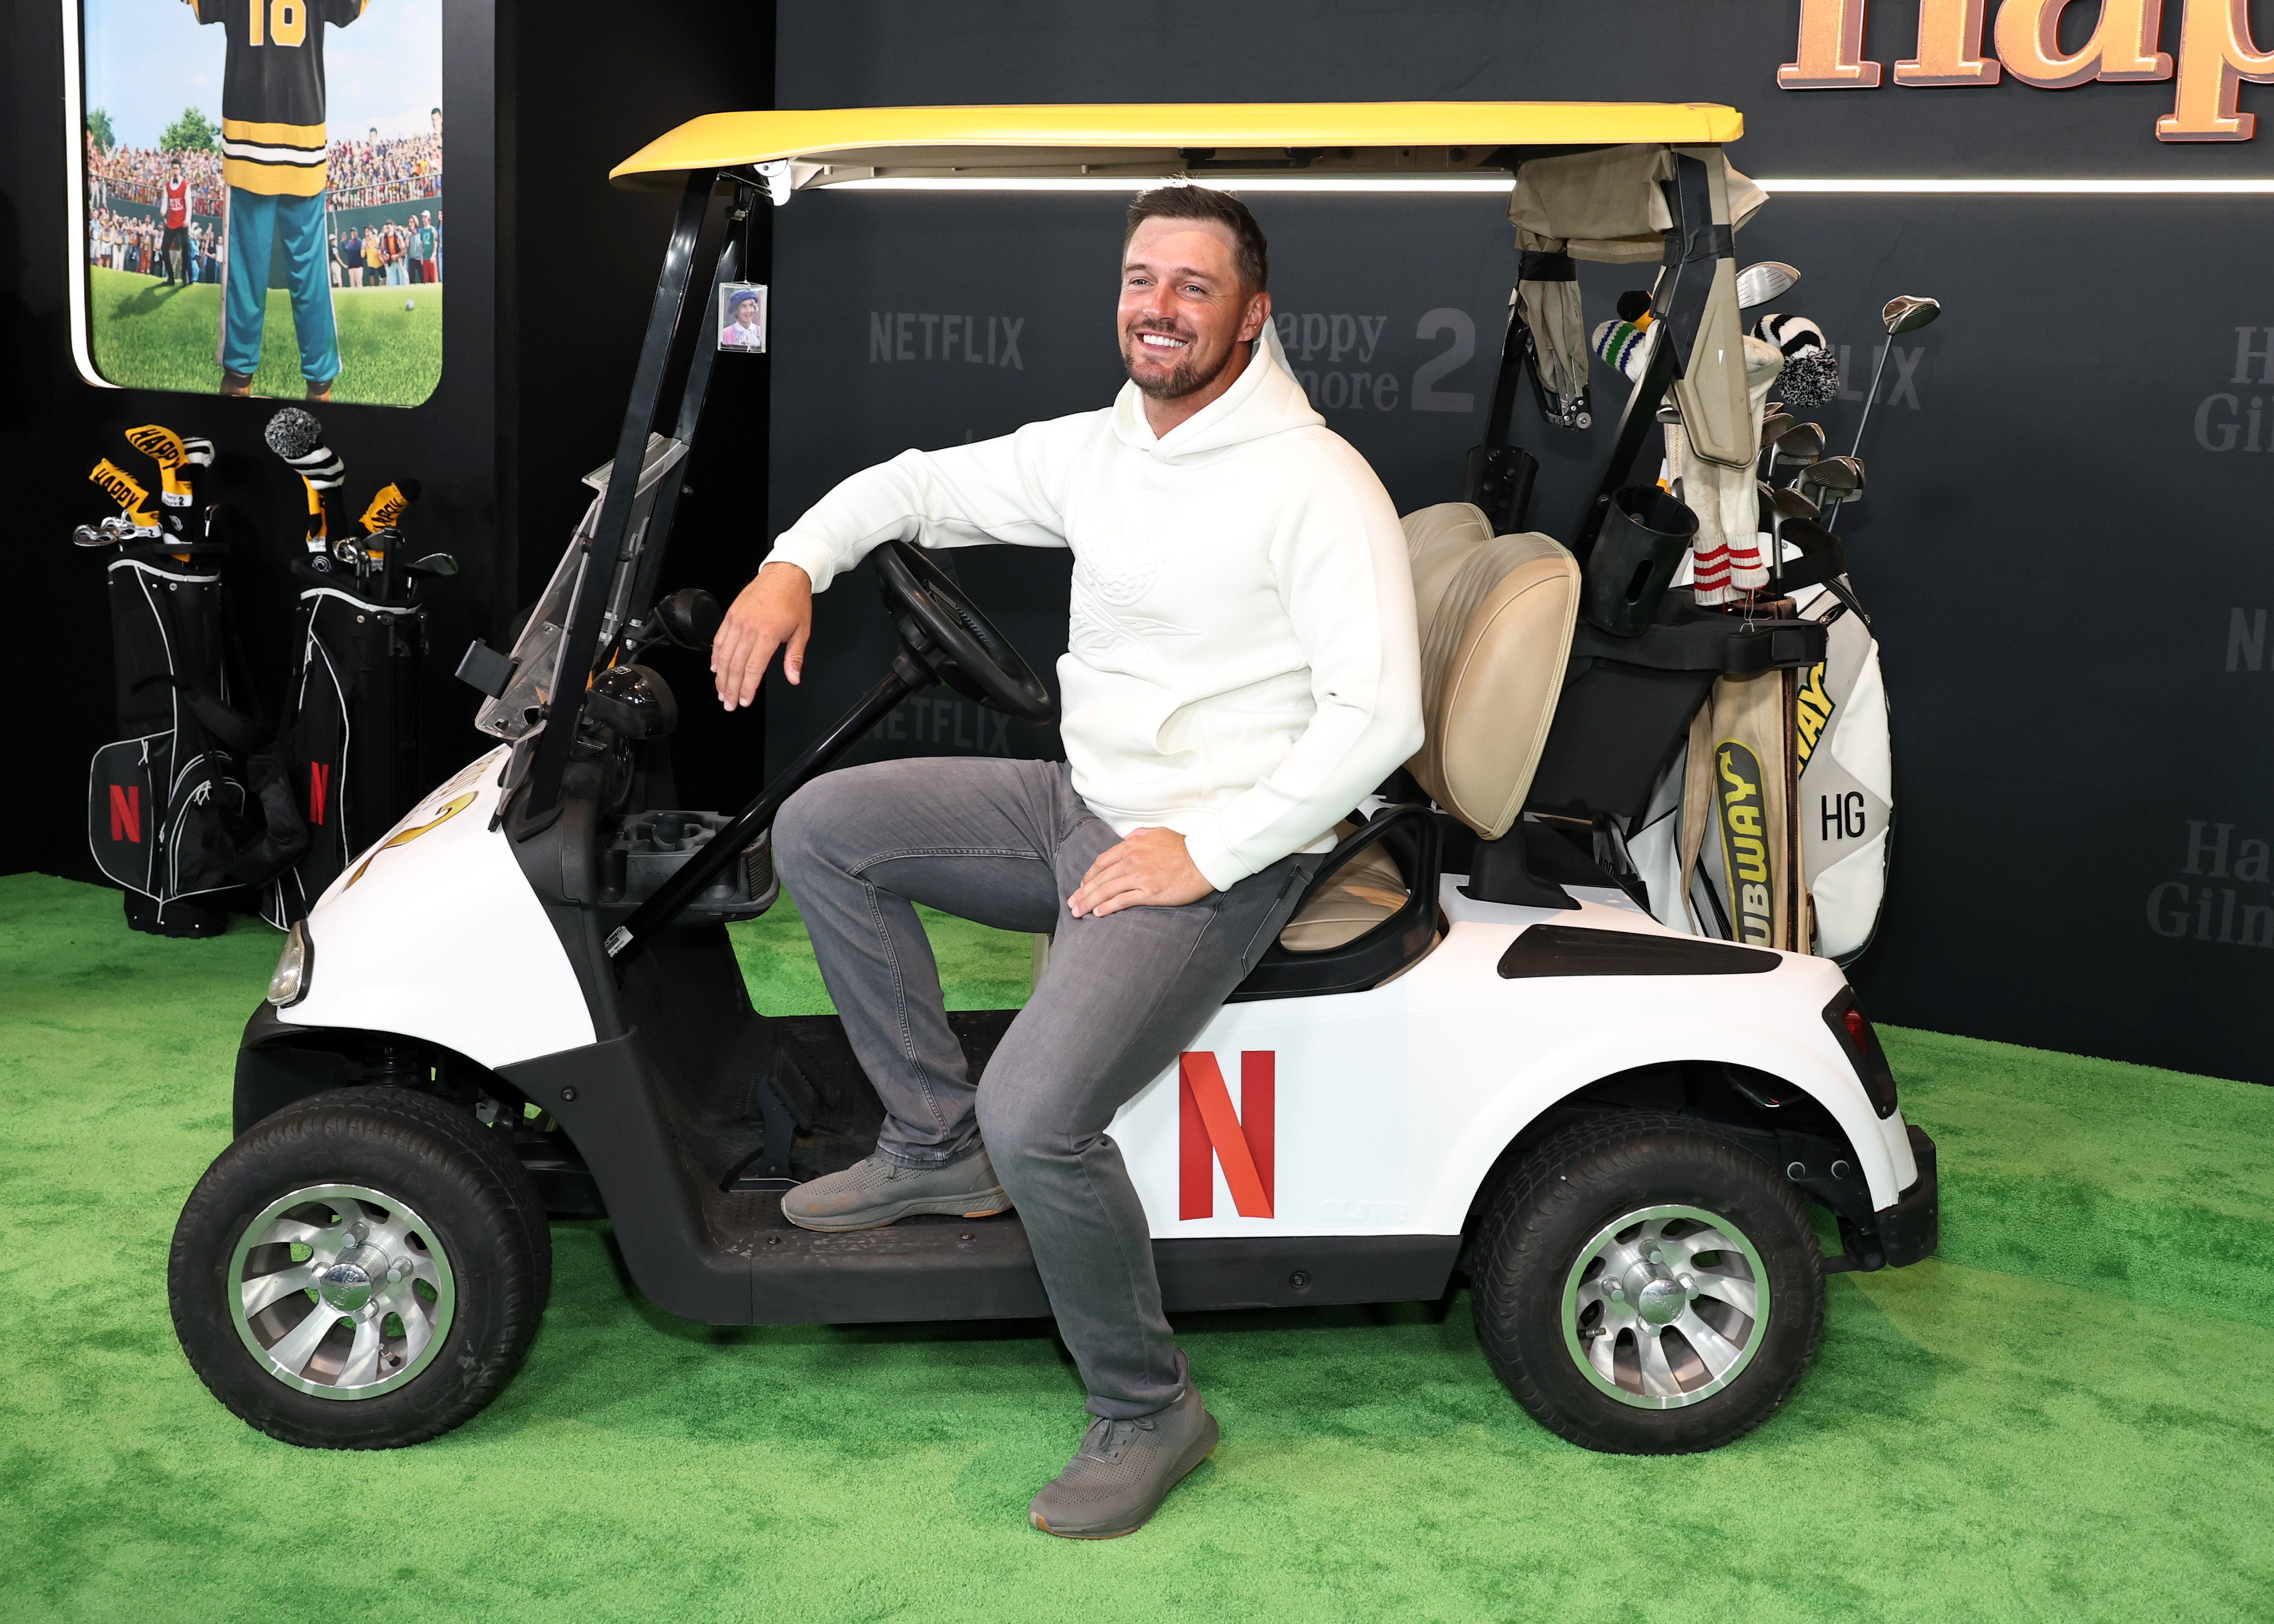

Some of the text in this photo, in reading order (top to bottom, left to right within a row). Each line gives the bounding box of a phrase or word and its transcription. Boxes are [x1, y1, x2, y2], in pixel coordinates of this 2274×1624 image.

[870, 312, 1024, 371] NETFLIX
[1276, 312, 1387, 363] appy
[1411, 307, 1475, 413] 2
[130, 428, 181, 470] HAPPY
[93, 468, 140, 509] HAPPY
[178, 496, 184, 506] 2
[110, 784, 141, 843] N
[310, 761, 329, 826] N
[1821, 791, 1866, 840] HG
[1718, 750, 1773, 947] UBWAY
[1179, 1050, 1275, 1221] N
